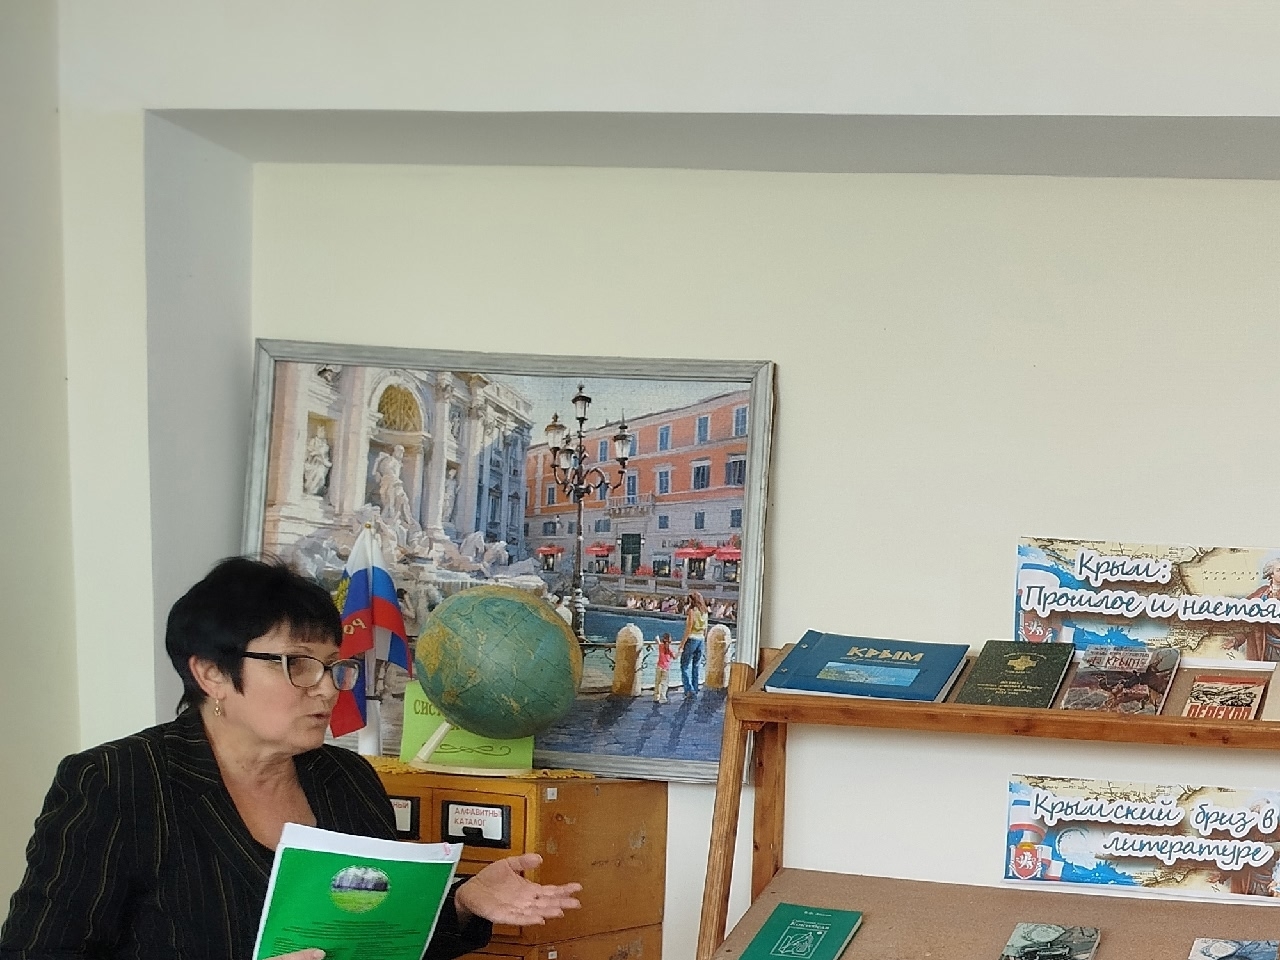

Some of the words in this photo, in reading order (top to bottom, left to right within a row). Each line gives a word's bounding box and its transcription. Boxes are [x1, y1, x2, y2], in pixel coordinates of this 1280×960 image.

[1078, 552, 1168, 581] Крым:
[1025, 585, 1142, 612] Прошлое
[1150, 598, 1174, 612] и
[846, 646, 925, 662] КРЫМ
[454, 818, 486, 827] КАТАЛОГ
[1033, 795, 1181, 821] Крымский
[1194, 803, 1254, 832] бриз
[1262, 807, 1275, 829] в
[1102, 836, 1269, 866] литературе
